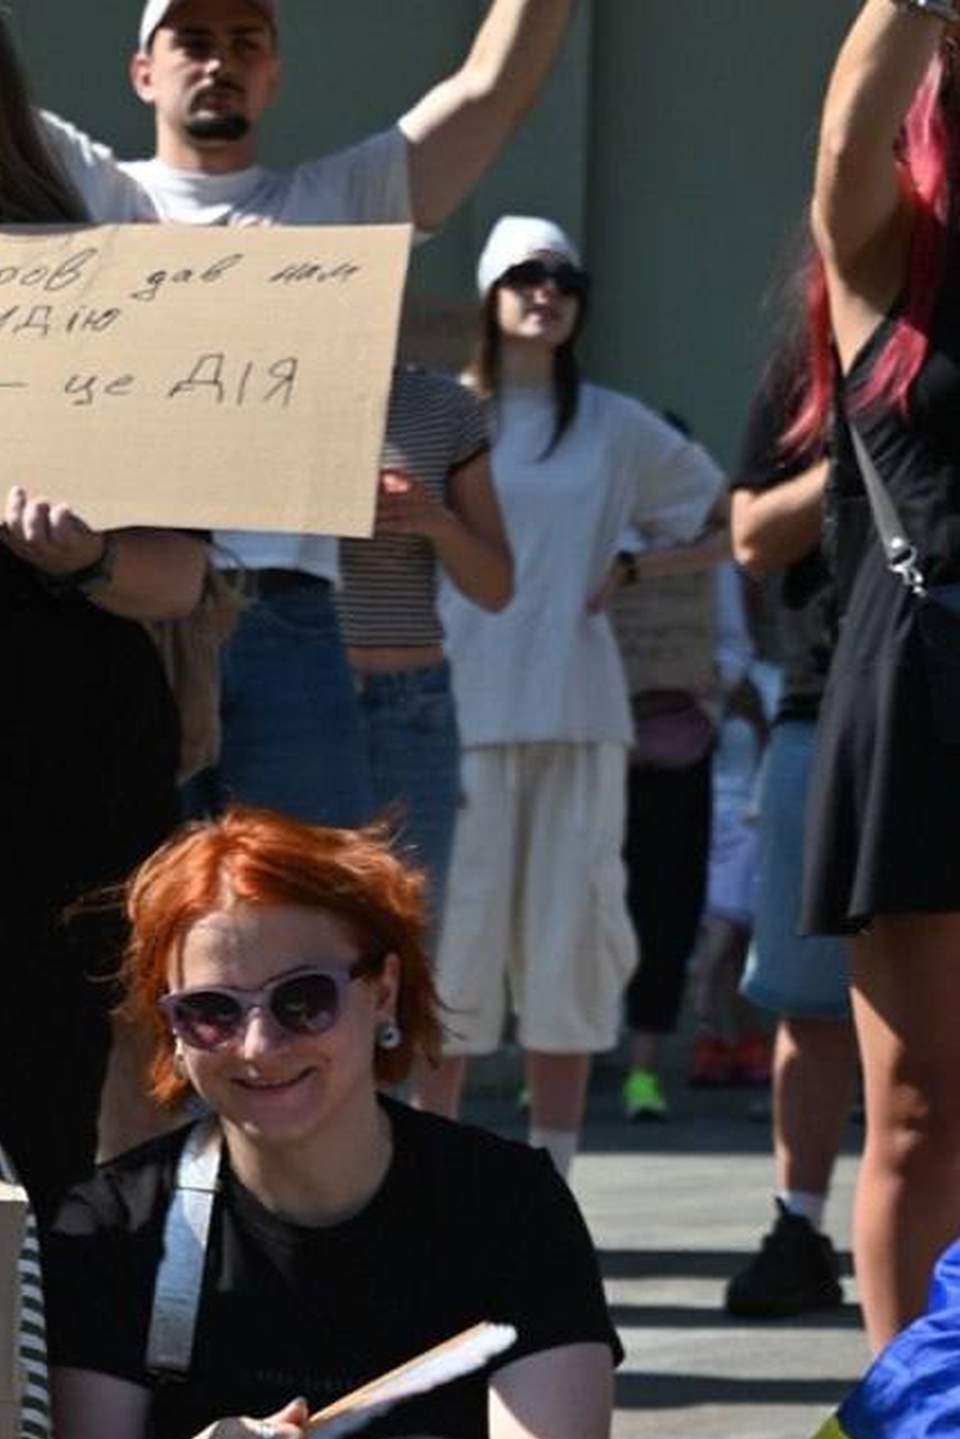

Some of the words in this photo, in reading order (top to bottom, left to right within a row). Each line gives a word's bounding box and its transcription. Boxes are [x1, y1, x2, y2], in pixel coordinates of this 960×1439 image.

[131, 254, 244, 302] дав
[63, 371, 137, 406] це
[167, 352, 300, 407] ДІЯ
